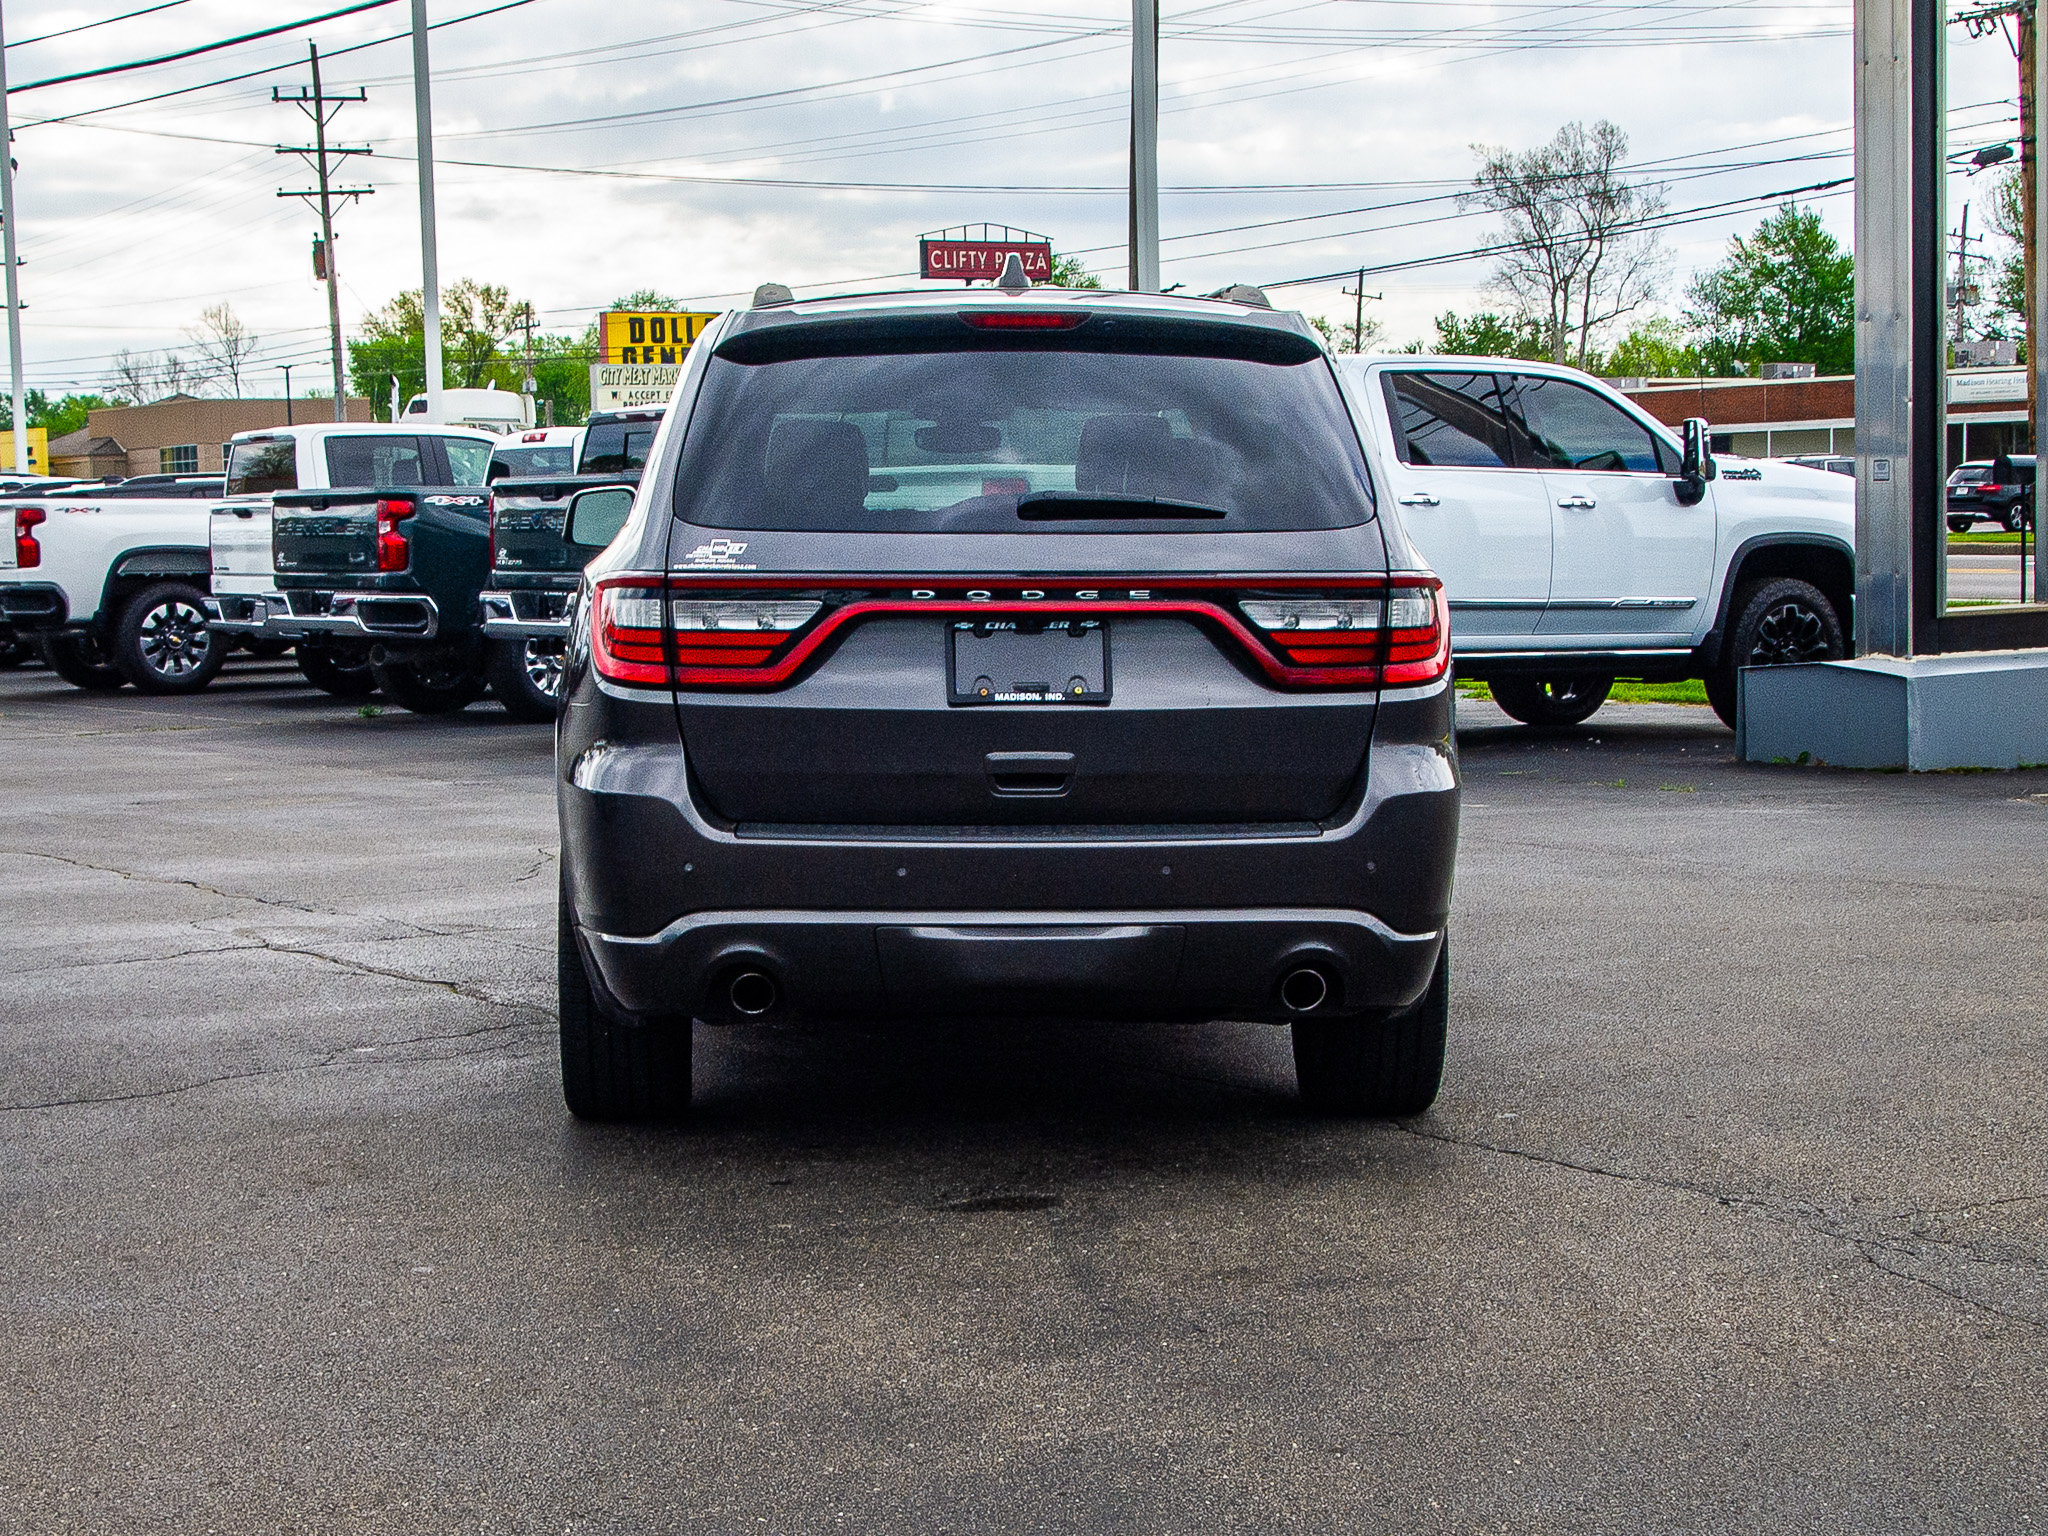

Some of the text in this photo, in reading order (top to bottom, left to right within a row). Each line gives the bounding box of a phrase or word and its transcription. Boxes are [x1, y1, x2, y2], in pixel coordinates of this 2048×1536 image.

[930, 250, 1047, 270] CLIFTY PZA
[629, 317, 713, 344] DOLL
[600, 366, 623, 386] CITY
[623, 366, 651, 386] MEAT
[628, 390, 661, 400] ACCEPT
[911, 589, 1151, 600] DODGE
[984, 621, 1071, 630] CHAER
[1044, 692, 1066, 701] IND.
